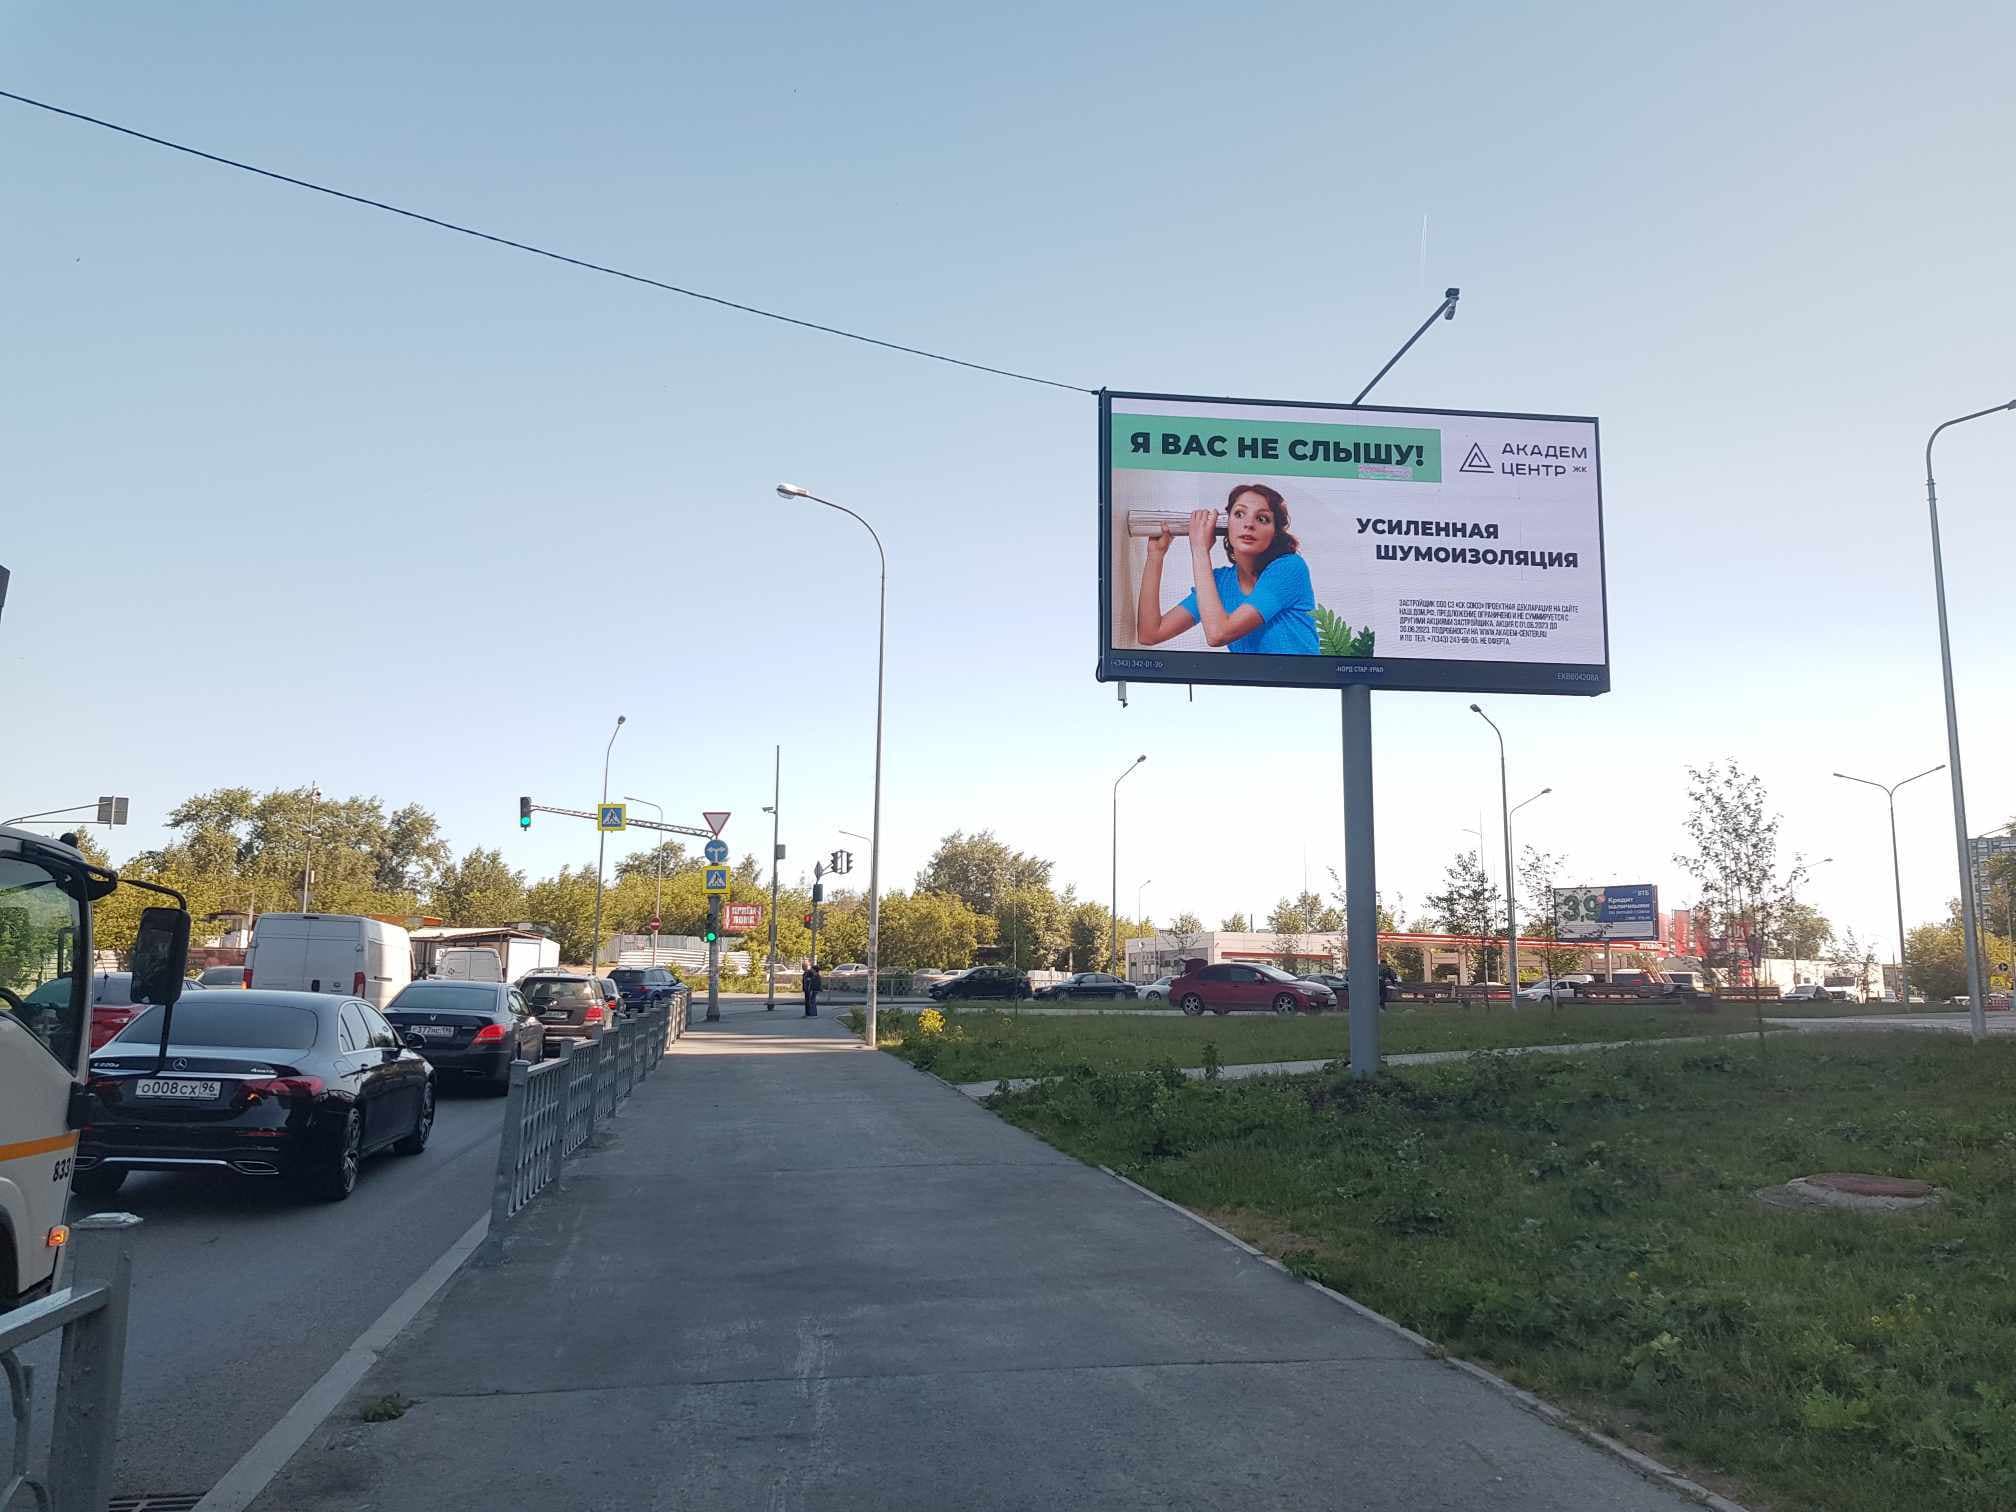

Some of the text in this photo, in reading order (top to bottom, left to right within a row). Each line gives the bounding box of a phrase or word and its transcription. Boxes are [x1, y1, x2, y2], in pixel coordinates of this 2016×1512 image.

[1130, 431, 1424, 467] Я ВАС НЕ СЛЫШУ!
[1501, 442, 1588, 460] АКАДЕМ
[1501, 462, 1567, 478] ЦЕНТР
[1356, 517, 1499, 540] УСИЛЕННАЯ
[1375, 544, 1579, 570] ШУМОИЗОЛЯЦИЯ
[1399, 598, 1434, 607] ЗАСТРОЙЩИК
[1485, 601, 1515, 610] ПРОЕКТНАЯ
[1516, 603, 1552, 611] ДЕКЛАРАЦИЯ
[1561, 604, 1577, 612] САЙТЕ
[1399, 616, 1426, 624] ДРУГИМИ
[1427, 617, 1452, 625] АКЦИЯМИ
[1436, 609, 1476, 617] ПРЕДЛОЖЕНИЕ
[1477, 611, 1511, 619] ОГРАНИЧЕНО
[1525, 612, 1563, 620] СУММИРУЕТСЯ
[1432, 626, 1469, 634] ПОДРОБНОСТИ
[1607, 896, 1634, 904] Кредит
[201, 1082, 216, 1093] 96
[53, 1157, 72, 1182] 833
